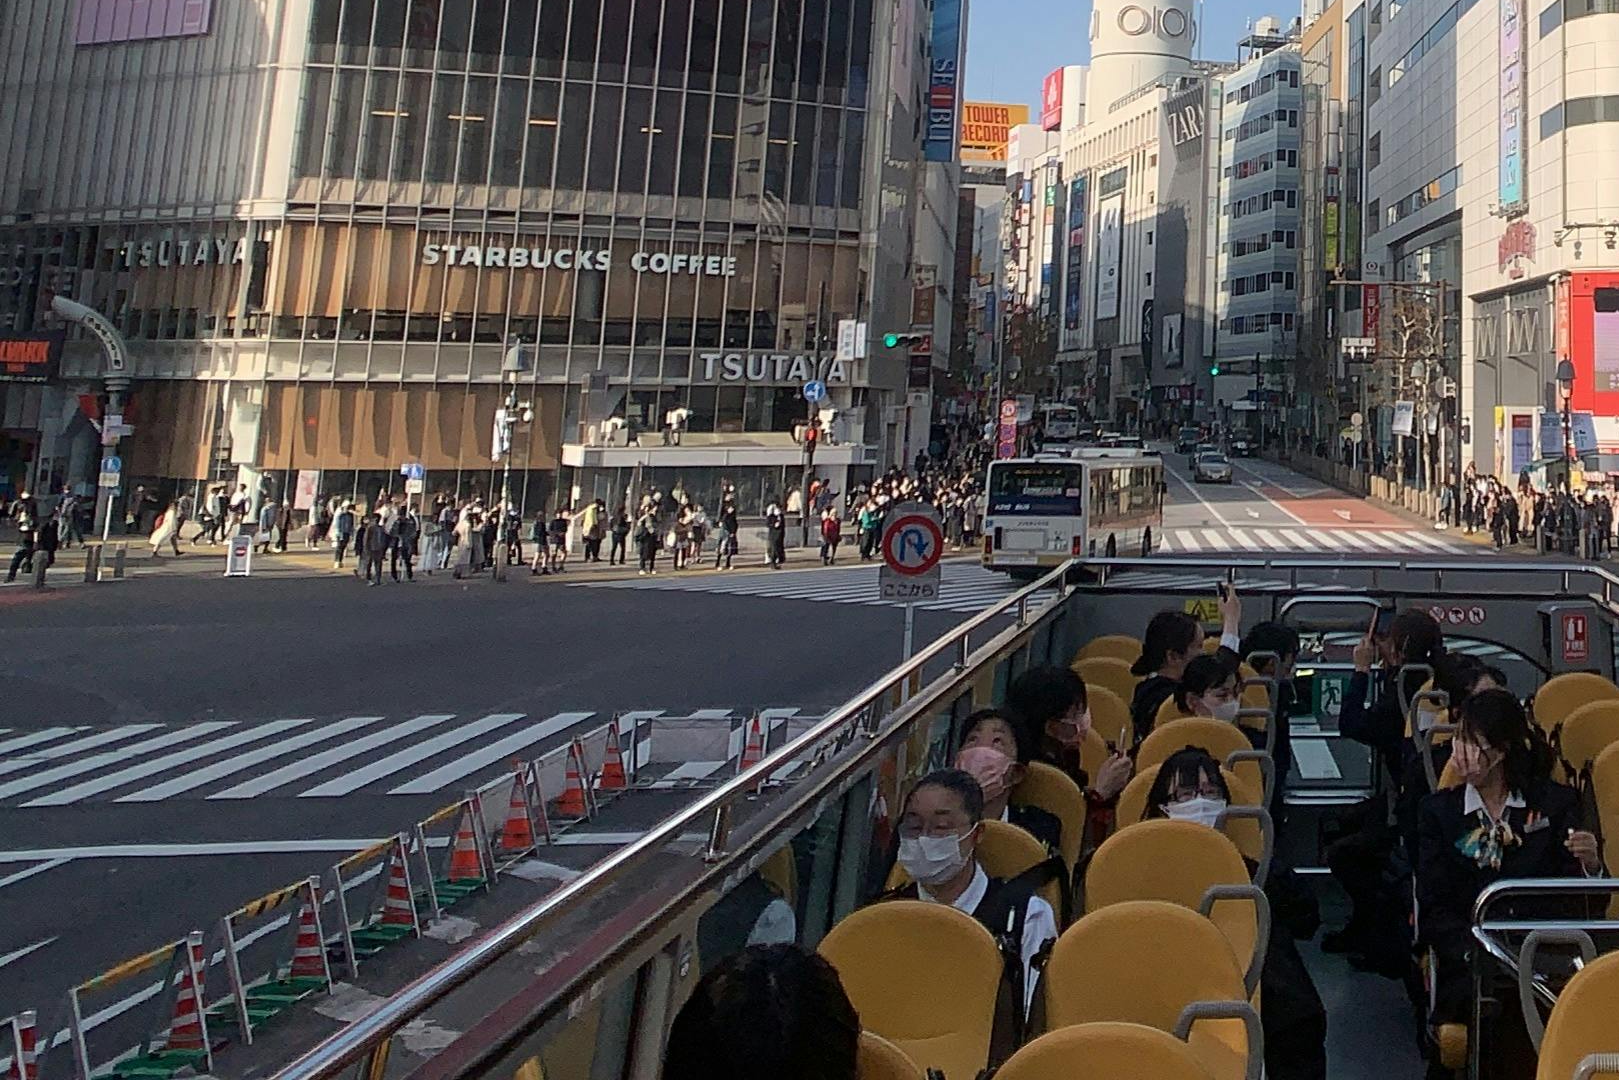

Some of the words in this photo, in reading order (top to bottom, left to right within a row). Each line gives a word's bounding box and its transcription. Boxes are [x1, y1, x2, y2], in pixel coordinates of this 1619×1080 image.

[929, 58, 954, 140] SEIBU
[965, 106, 1009, 124] TOWER
[121, 236, 247, 267] TSUTAYA
[422, 243, 611, 272] STARBUCKS
[631, 251, 736, 277] COFFEE
[700, 352, 848, 383] TSUTAYA
[884, 583, 934, 598] ここから
